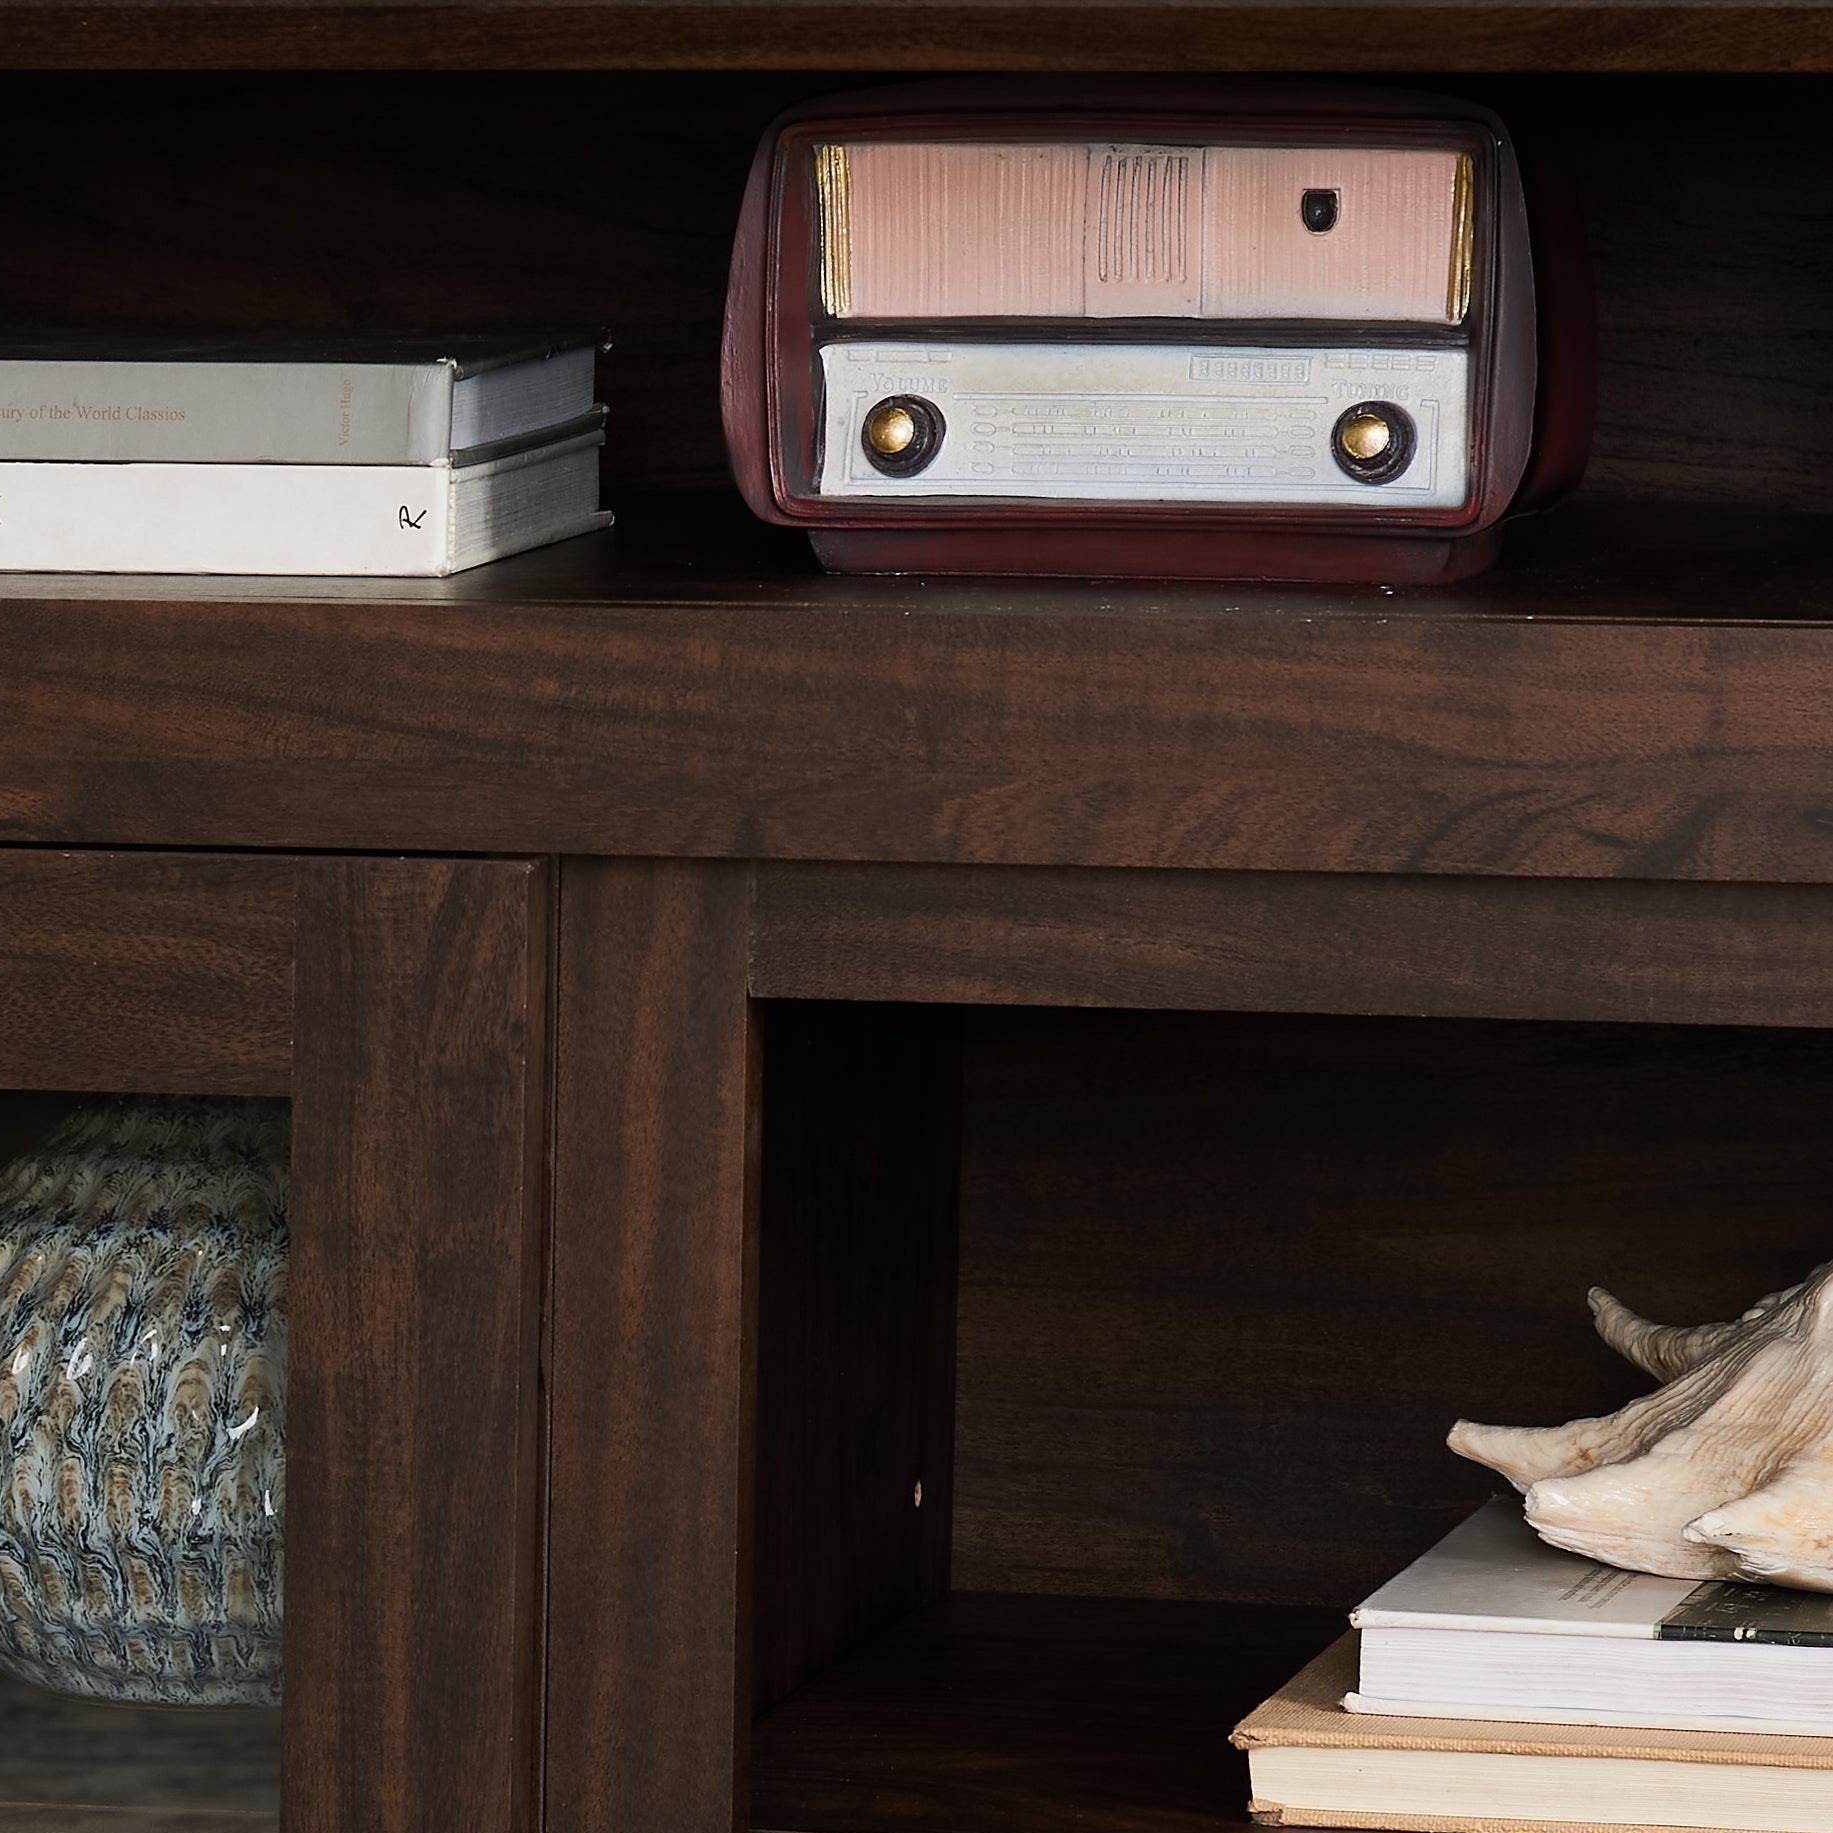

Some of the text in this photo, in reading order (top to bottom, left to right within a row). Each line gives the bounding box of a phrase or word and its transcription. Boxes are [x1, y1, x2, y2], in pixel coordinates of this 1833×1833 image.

[1331, 379, 1409, 401] TUNING
[29, 405, 45, 419] of
[49, 405, 71, 420] the
[75, 405, 121, 421] World
[338, 379, 354, 446] Victor Hugo
